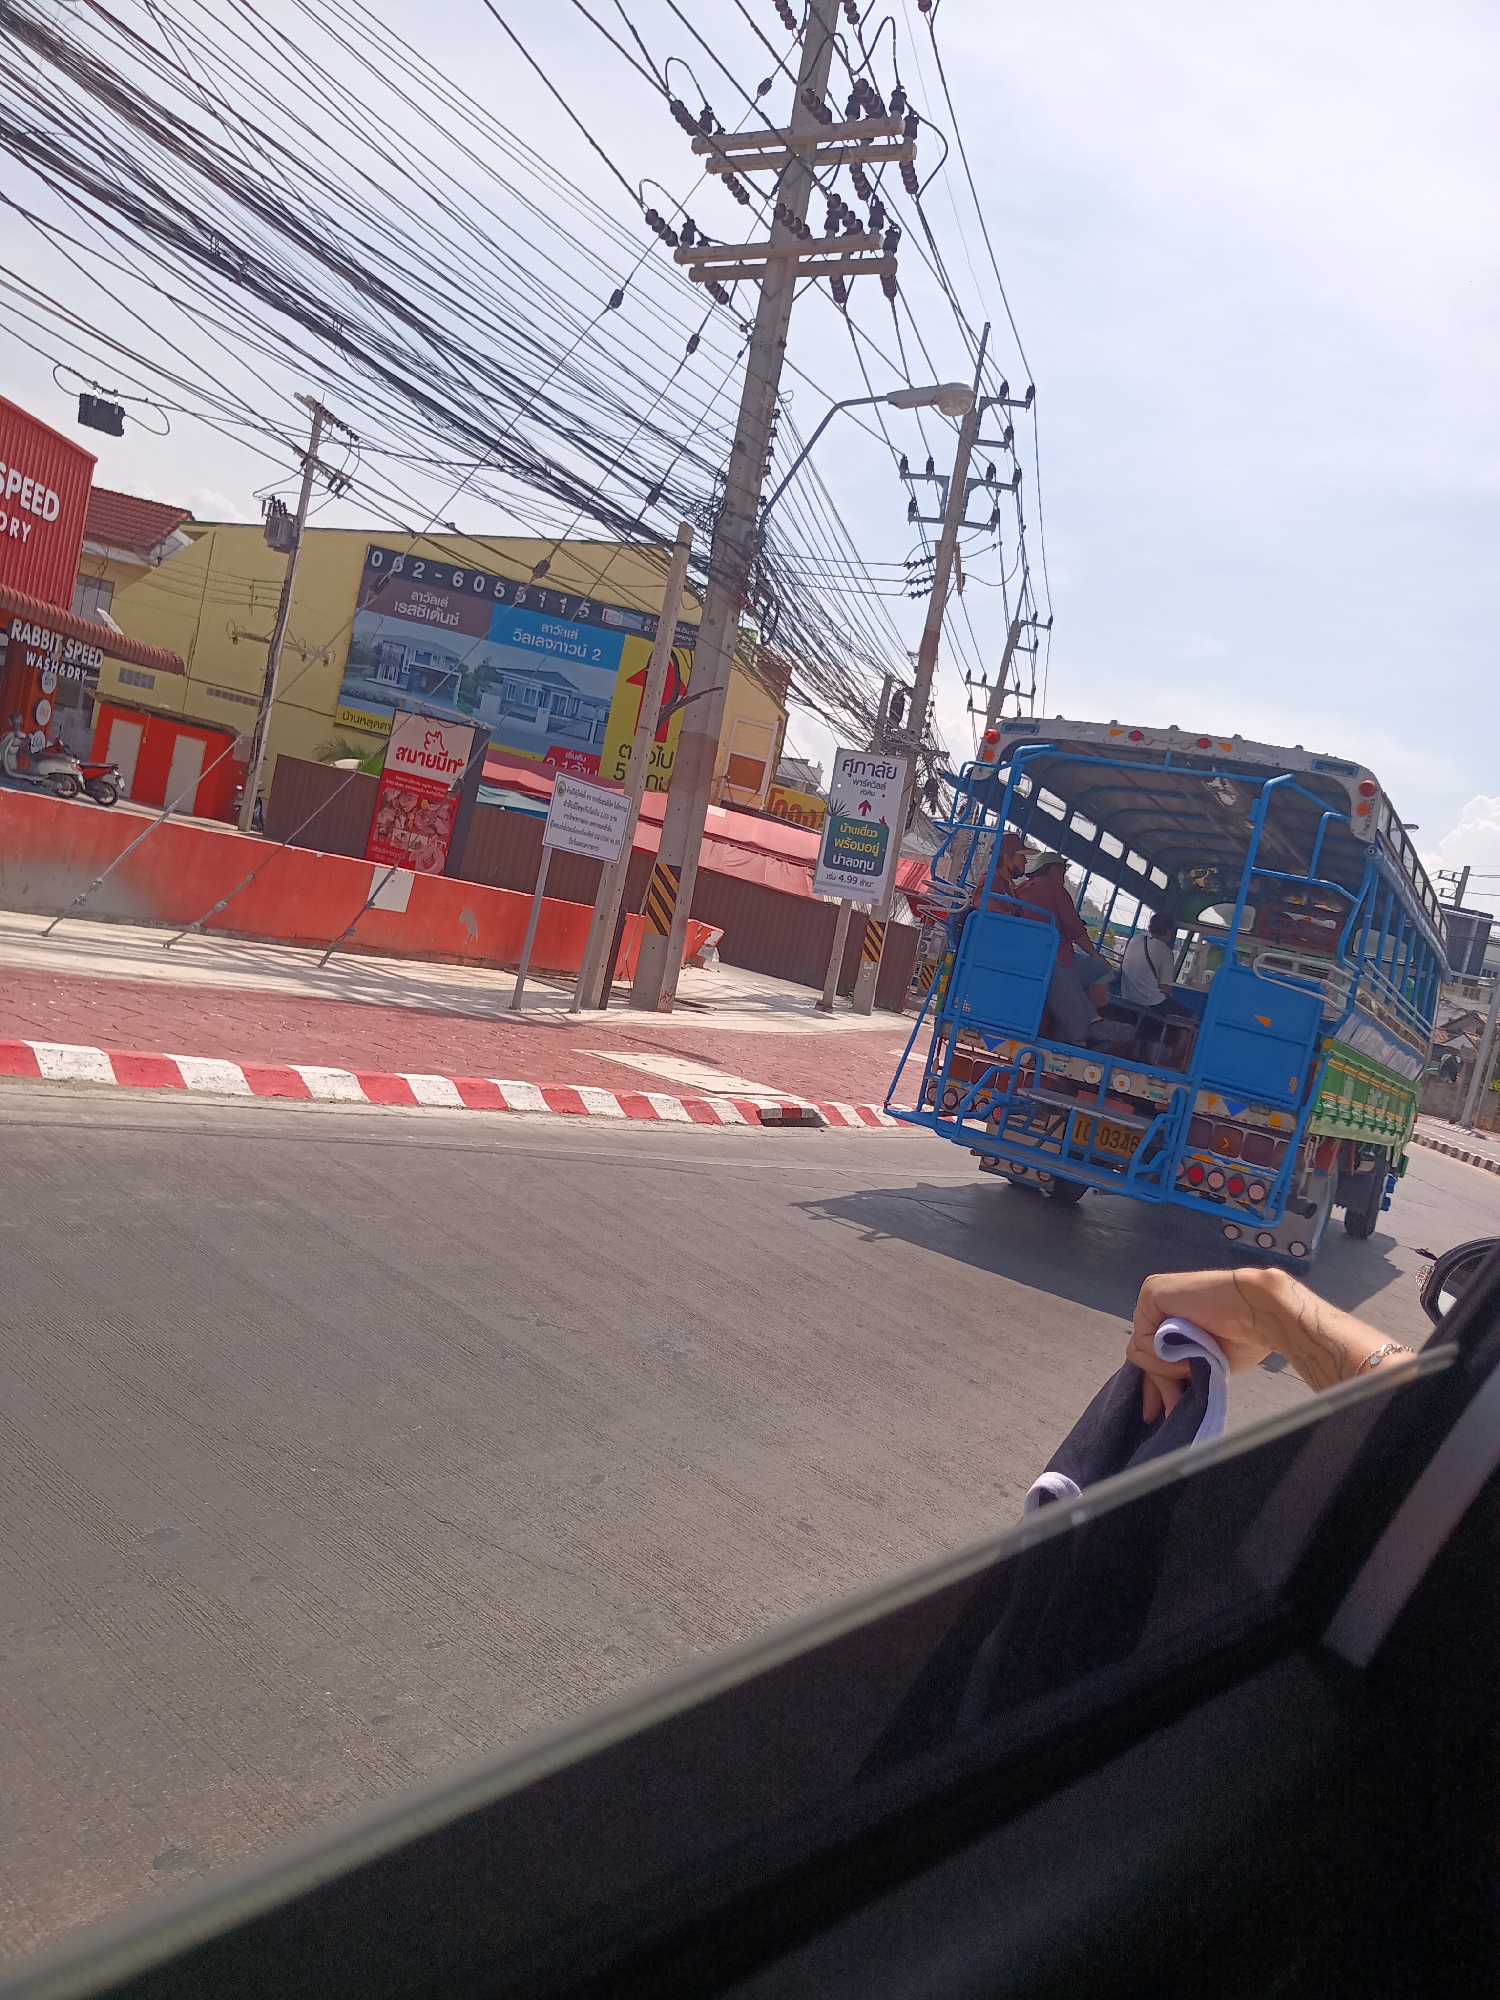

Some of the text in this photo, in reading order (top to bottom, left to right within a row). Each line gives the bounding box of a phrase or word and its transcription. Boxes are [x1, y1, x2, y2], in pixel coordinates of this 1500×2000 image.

[11, 617, 104, 668] RABBIT SPEED
[591, 648, 602, 662] 2
[25, 651, 87, 681] WASH&DRY
[618, 744, 674, 769] ตงไป
[613, 762, 626, 781] 5
[842, 758, 898, 780] ศุภาลัย
[840, 822, 878, 839] บ้านเดี่ยว
[834, 837, 880, 858] พร้อมอยู่
[832, 853, 875, 873] น่าลงทุน
[838, 873, 858, 885] 4.99
